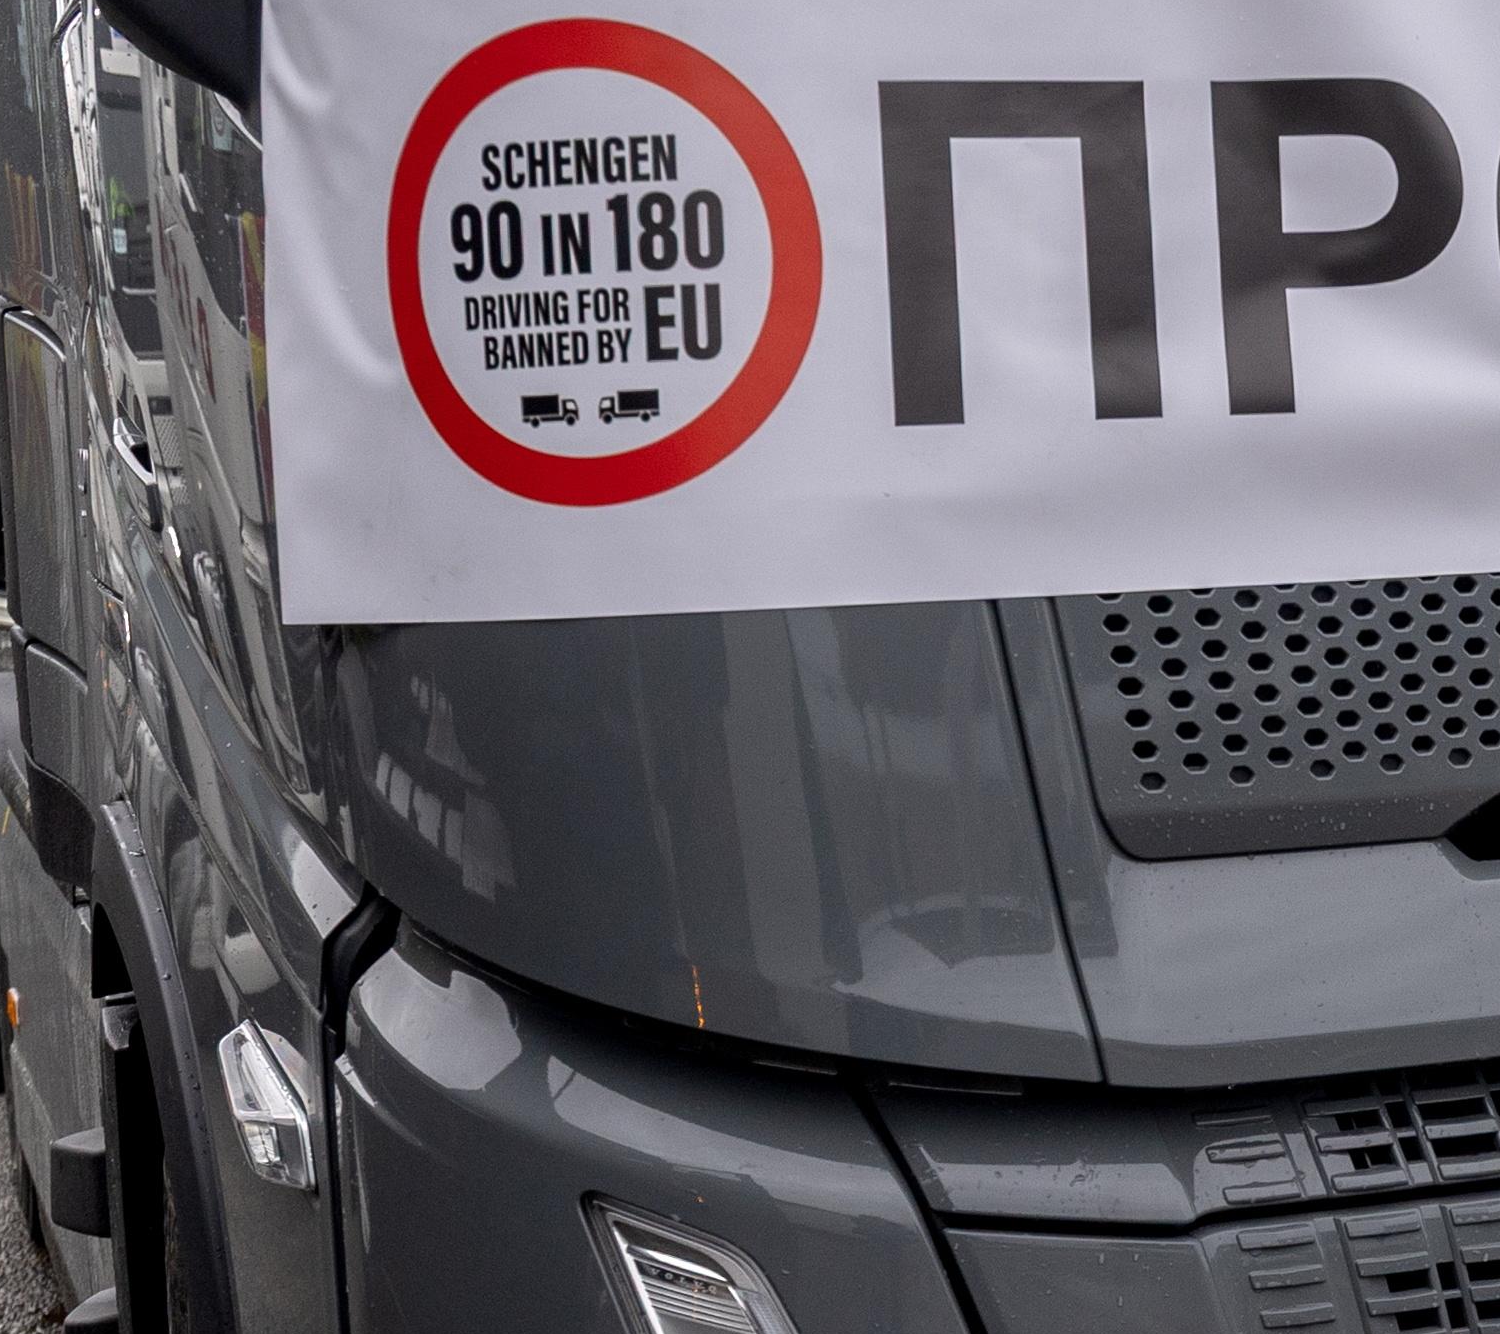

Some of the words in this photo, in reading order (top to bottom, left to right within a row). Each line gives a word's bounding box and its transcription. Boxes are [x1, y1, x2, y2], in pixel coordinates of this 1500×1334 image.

[481, 134, 678, 191] SCHENGEN
[450, 199, 524, 282] 90
[541, 212, 592, 277] IN
[606, 189, 724, 272] 180
[464, 290, 570, 331] DRIVING
[577, 288, 630, 324] FOR
[644, 282, 722, 361] EU
[484, 330, 590, 371] BANNED
[598, 328, 633, 364] BY
